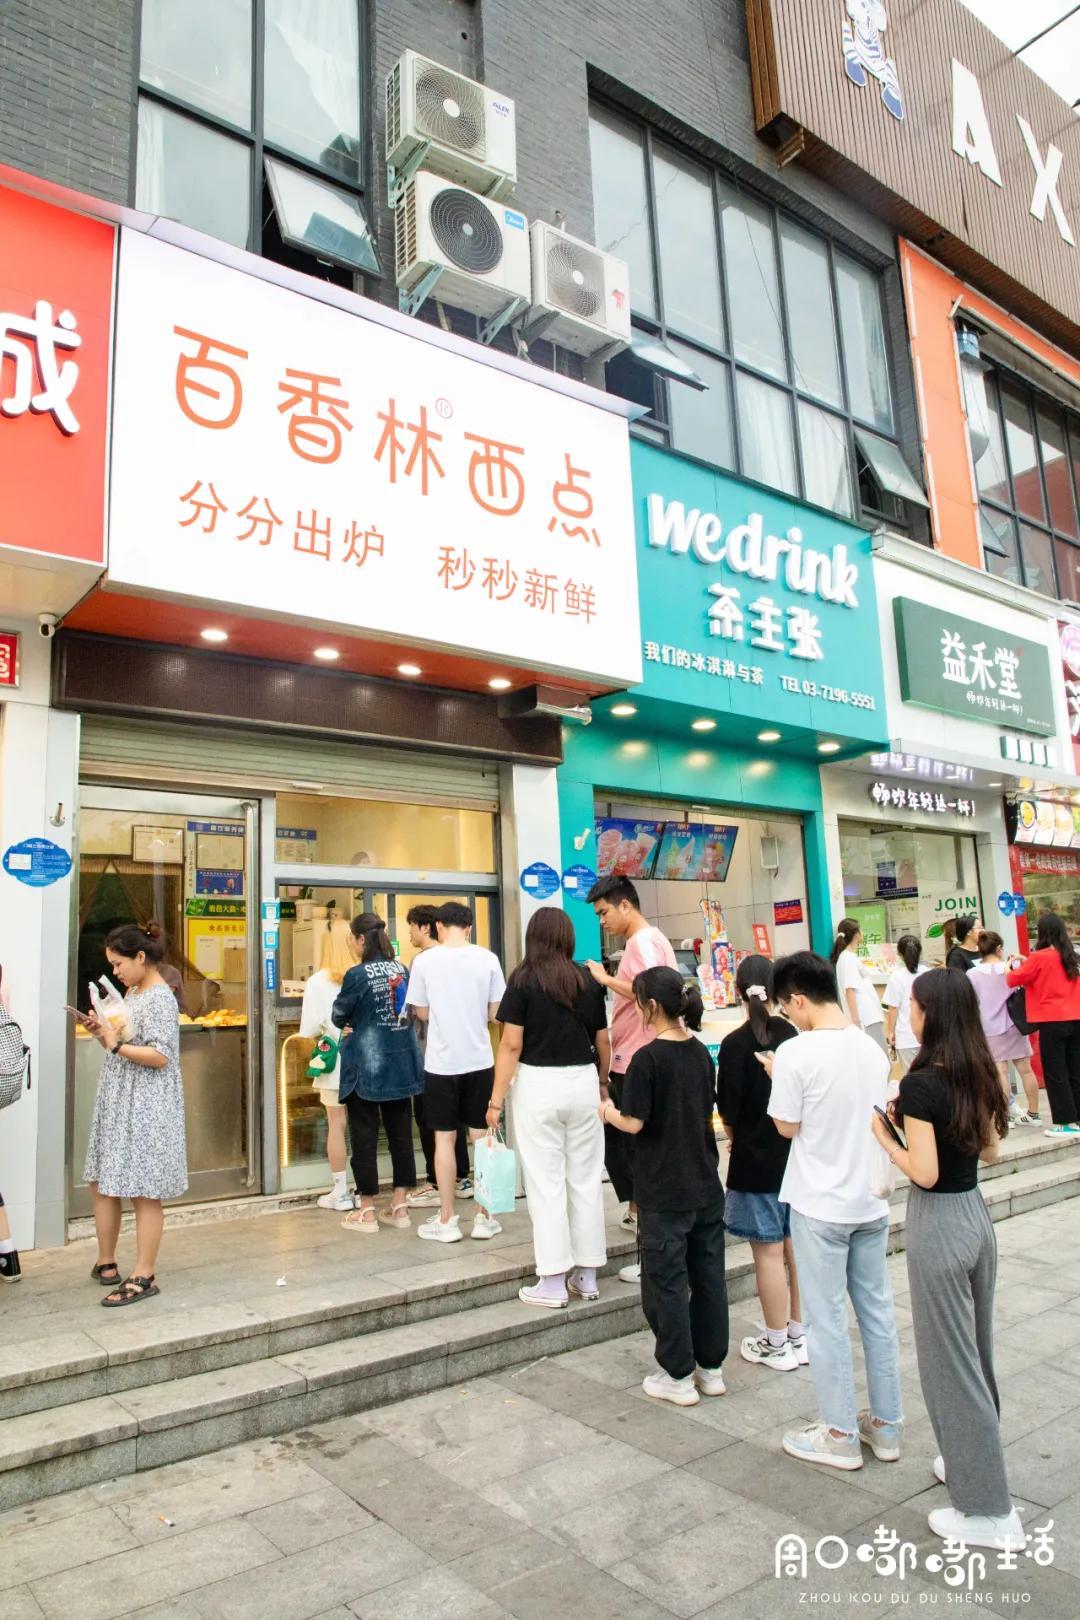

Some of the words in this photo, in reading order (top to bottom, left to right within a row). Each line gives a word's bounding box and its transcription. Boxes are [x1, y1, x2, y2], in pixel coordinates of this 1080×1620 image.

[178, 479, 385, 569] 分分出炉
[437, 545, 597, 625] 秒秒新鲜
[707, 582, 824, 661] 茶主张
[645, 641, 764, 685] 我们的冰淇淋与茶
[779, 674, 801, 694] TEL
[802, 680, 876, 711] 03-7196-5551
[940, 629, 1023, 700] 益禾堂
[934, 896, 977, 911] JOIN
